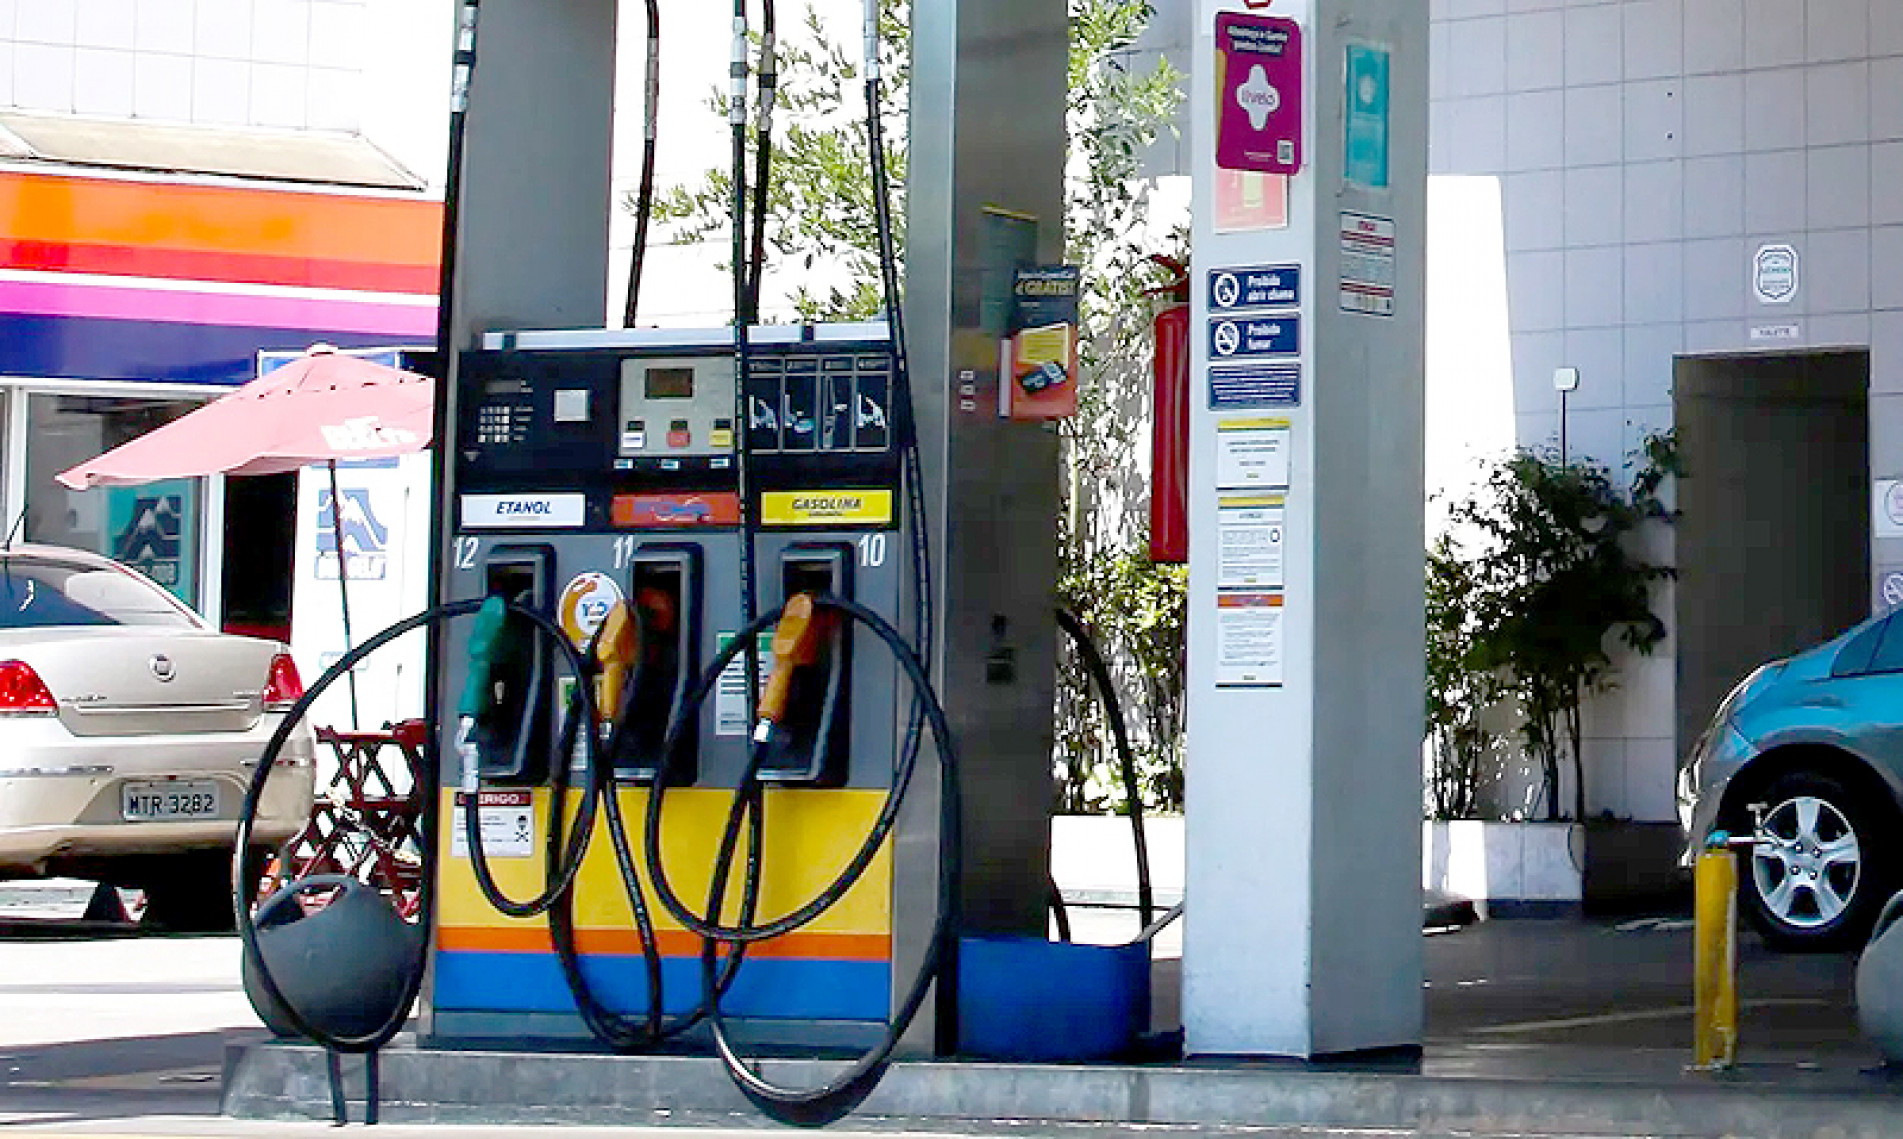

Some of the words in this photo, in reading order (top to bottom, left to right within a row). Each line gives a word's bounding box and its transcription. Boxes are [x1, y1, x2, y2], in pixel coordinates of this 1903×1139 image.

[496, 499, 553, 515] ETANOL
[791, 497, 862, 511] GASOLINA
[452, 537, 479, 569] 12
[613, 535, 634, 568] 11
[858, 533, 886, 567] 10
